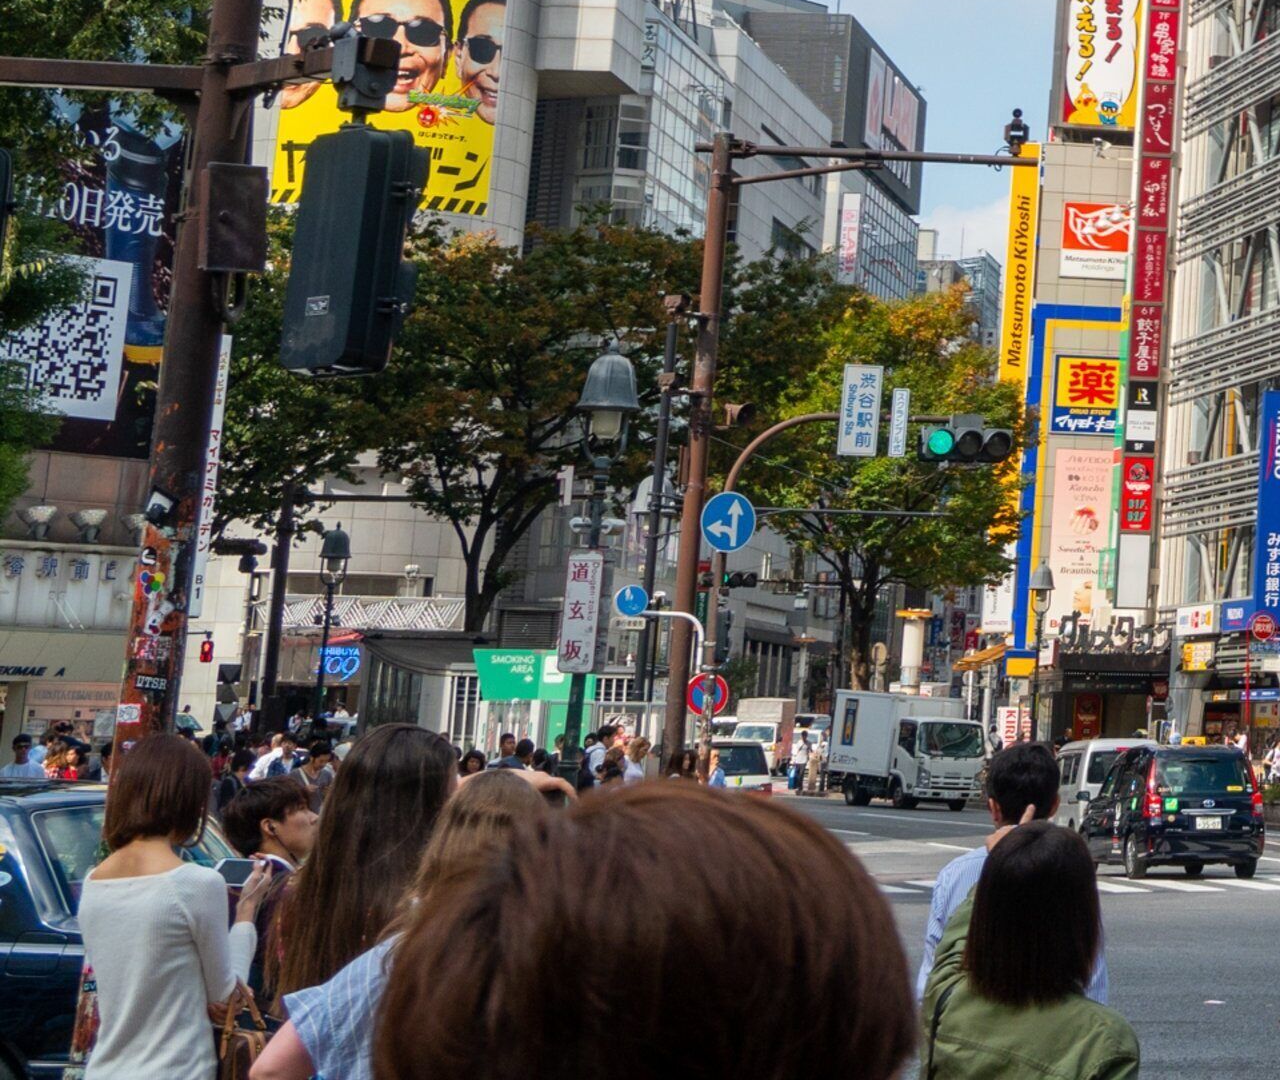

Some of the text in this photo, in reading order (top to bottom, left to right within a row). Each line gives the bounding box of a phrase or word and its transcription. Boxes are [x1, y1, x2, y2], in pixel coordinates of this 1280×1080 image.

[1158, 12, 1171, 21] 7F
[1153, 84, 1168, 93] 6F
[1149, 161, 1162, 169] 6F
[1145, 234, 1159, 244] 6F
[1007, 261, 1027, 368] Matsumoto
[1140, 307, 1156, 316] 6F
[1134, 318, 1153, 372] 餃子屋台
[1068, 361, 1117, 405] 薬
[844, 383, 858, 418] Shibuya
[854, 372, 877, 448] 渋谷駅前
[564, 562, 589, 661] 道玄坂
[490, 654, 535, 665] SMOKING
[510, 664, 534, 674] AREA
